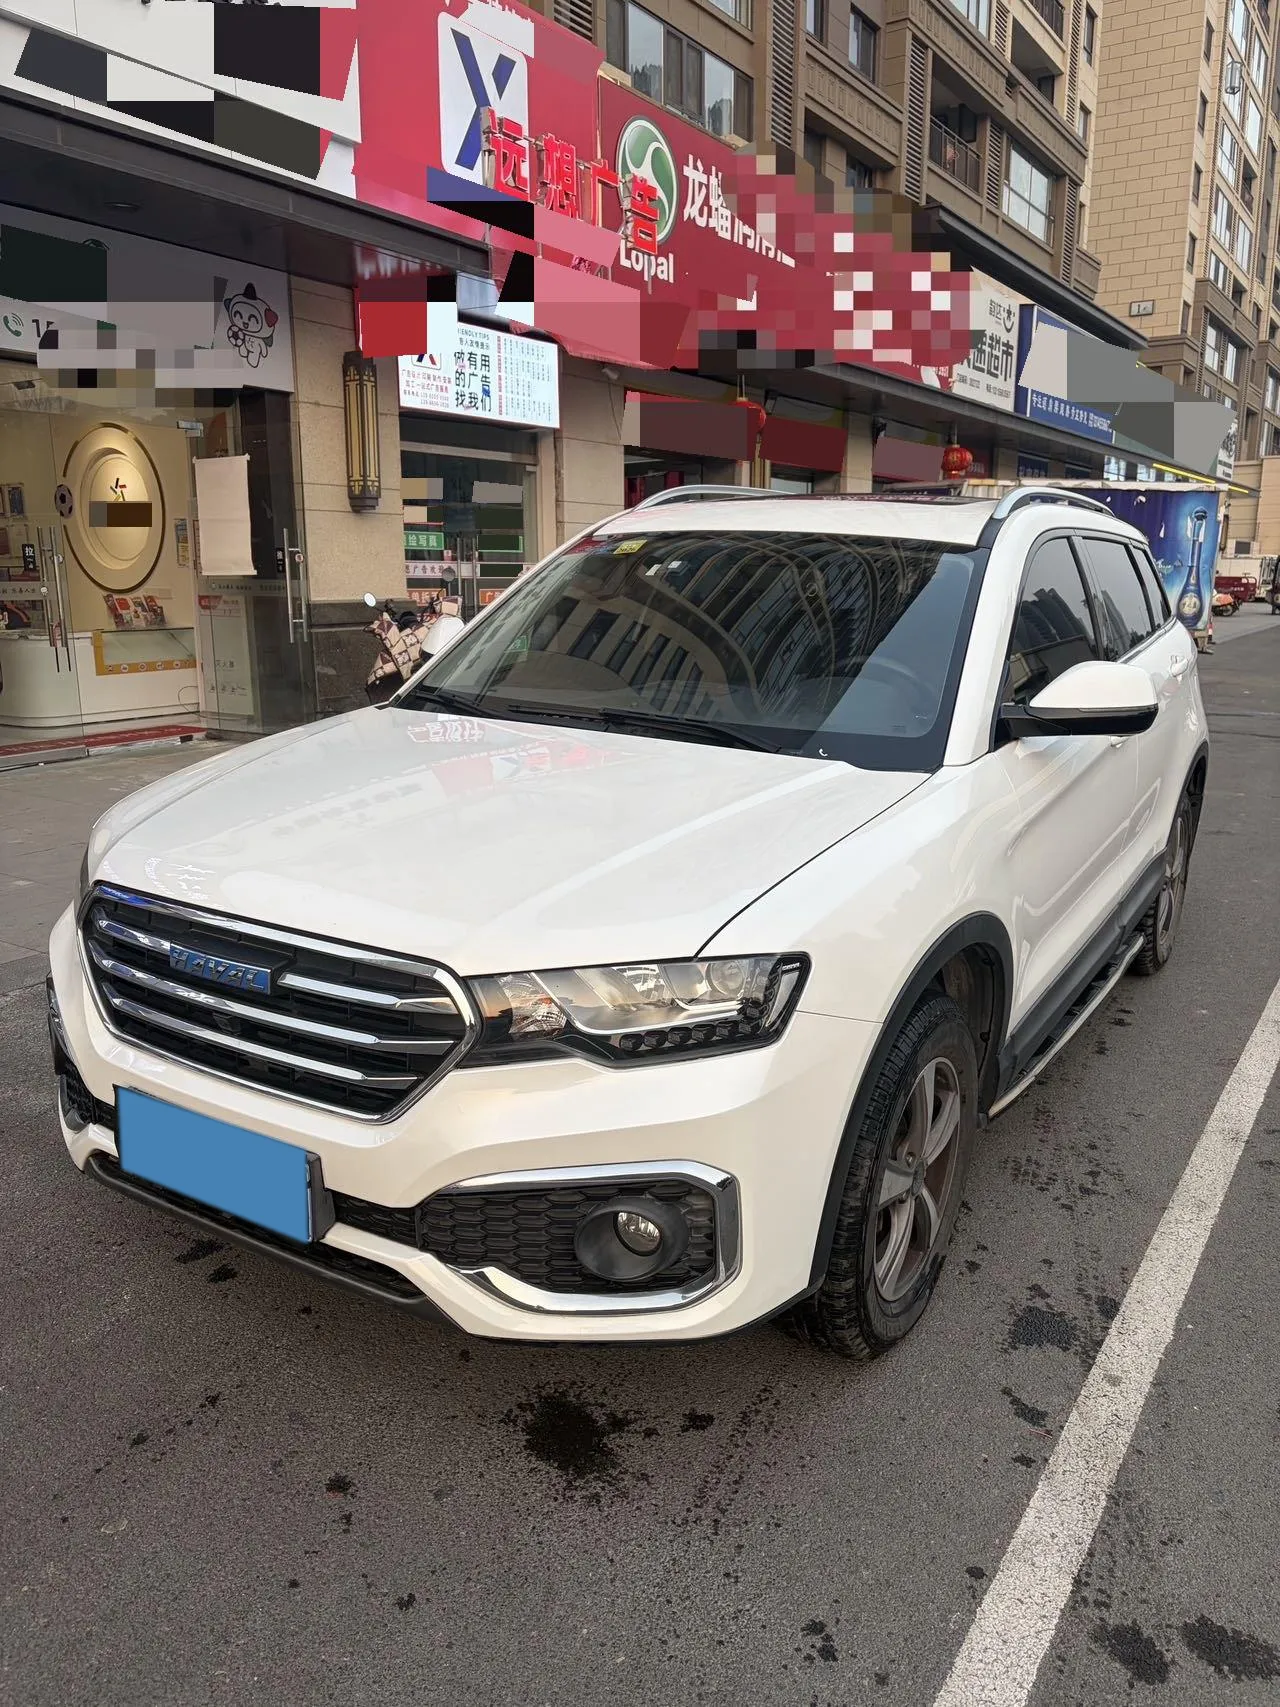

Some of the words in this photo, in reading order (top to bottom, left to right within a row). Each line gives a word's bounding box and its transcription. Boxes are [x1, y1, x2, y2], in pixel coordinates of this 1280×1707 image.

[485, 106, 661, 255] 远想广告
[620, 240, 675, 284] Lopal
[454, 349, 490, 373] 做有用
[455, 368, 491, 398] 的广告
[455, 388, 492, 412] 找我们
